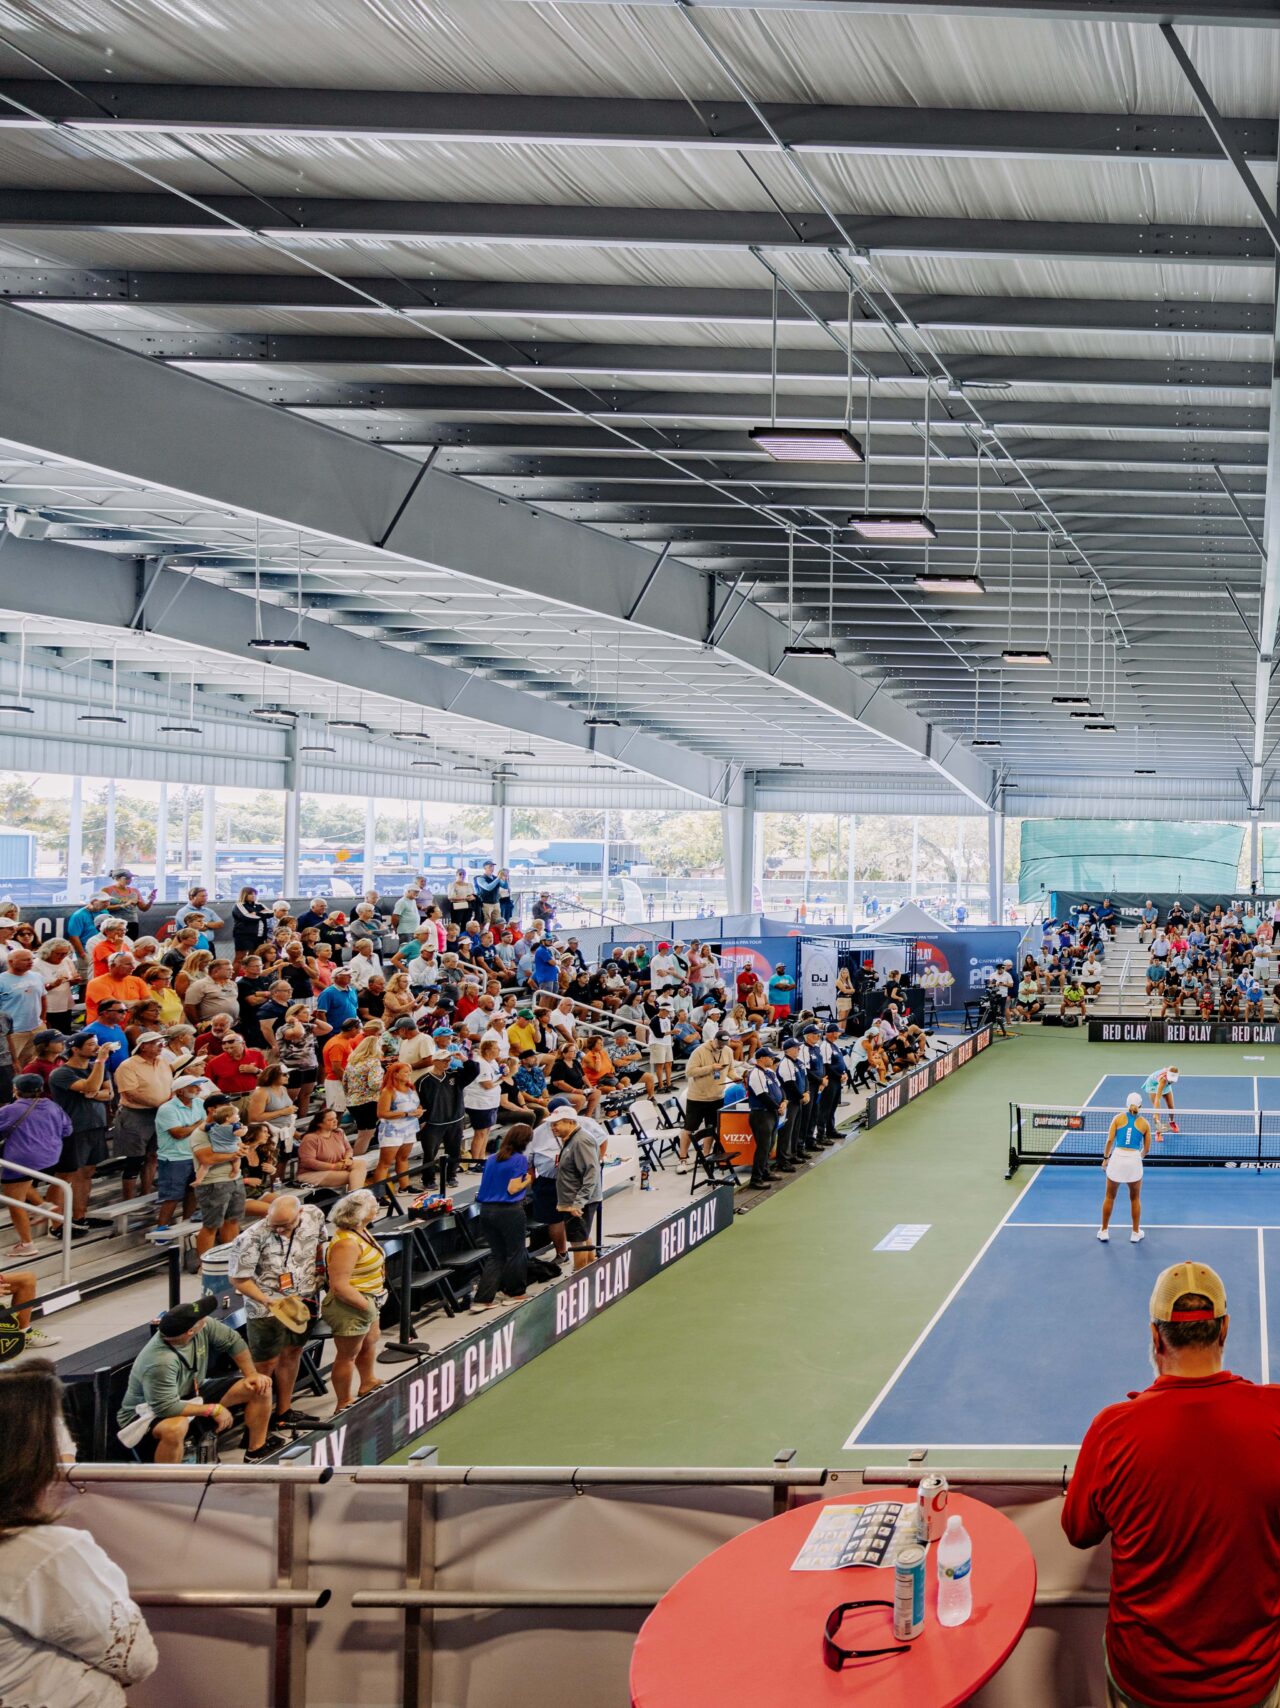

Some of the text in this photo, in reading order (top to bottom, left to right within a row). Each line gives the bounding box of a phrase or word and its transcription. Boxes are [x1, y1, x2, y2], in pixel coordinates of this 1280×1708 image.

[811, 974, 828, 982] DJ
[1103, 1024, 1147, 1041] RED CLAY
[1167, 1025, 1211, 1041] RED CLAY
[1232, 1026, 1276, 1042] RED CLAY
[908, 1067, 929, 1099] RED CLAY
[877, 1084, 900, 1120] RED CLAY
[1034, 1116, 1068, 1127] guaranteed
[722, 1134, 753, 1142] VIZZY
[661, 1197, 717, 1265] RED CLAY
[556, 1249, 632, 1335] RED CLAY
[409, 1320, 515, 1435] RED CLAY
[313, 1424, 348, 1467] AY
